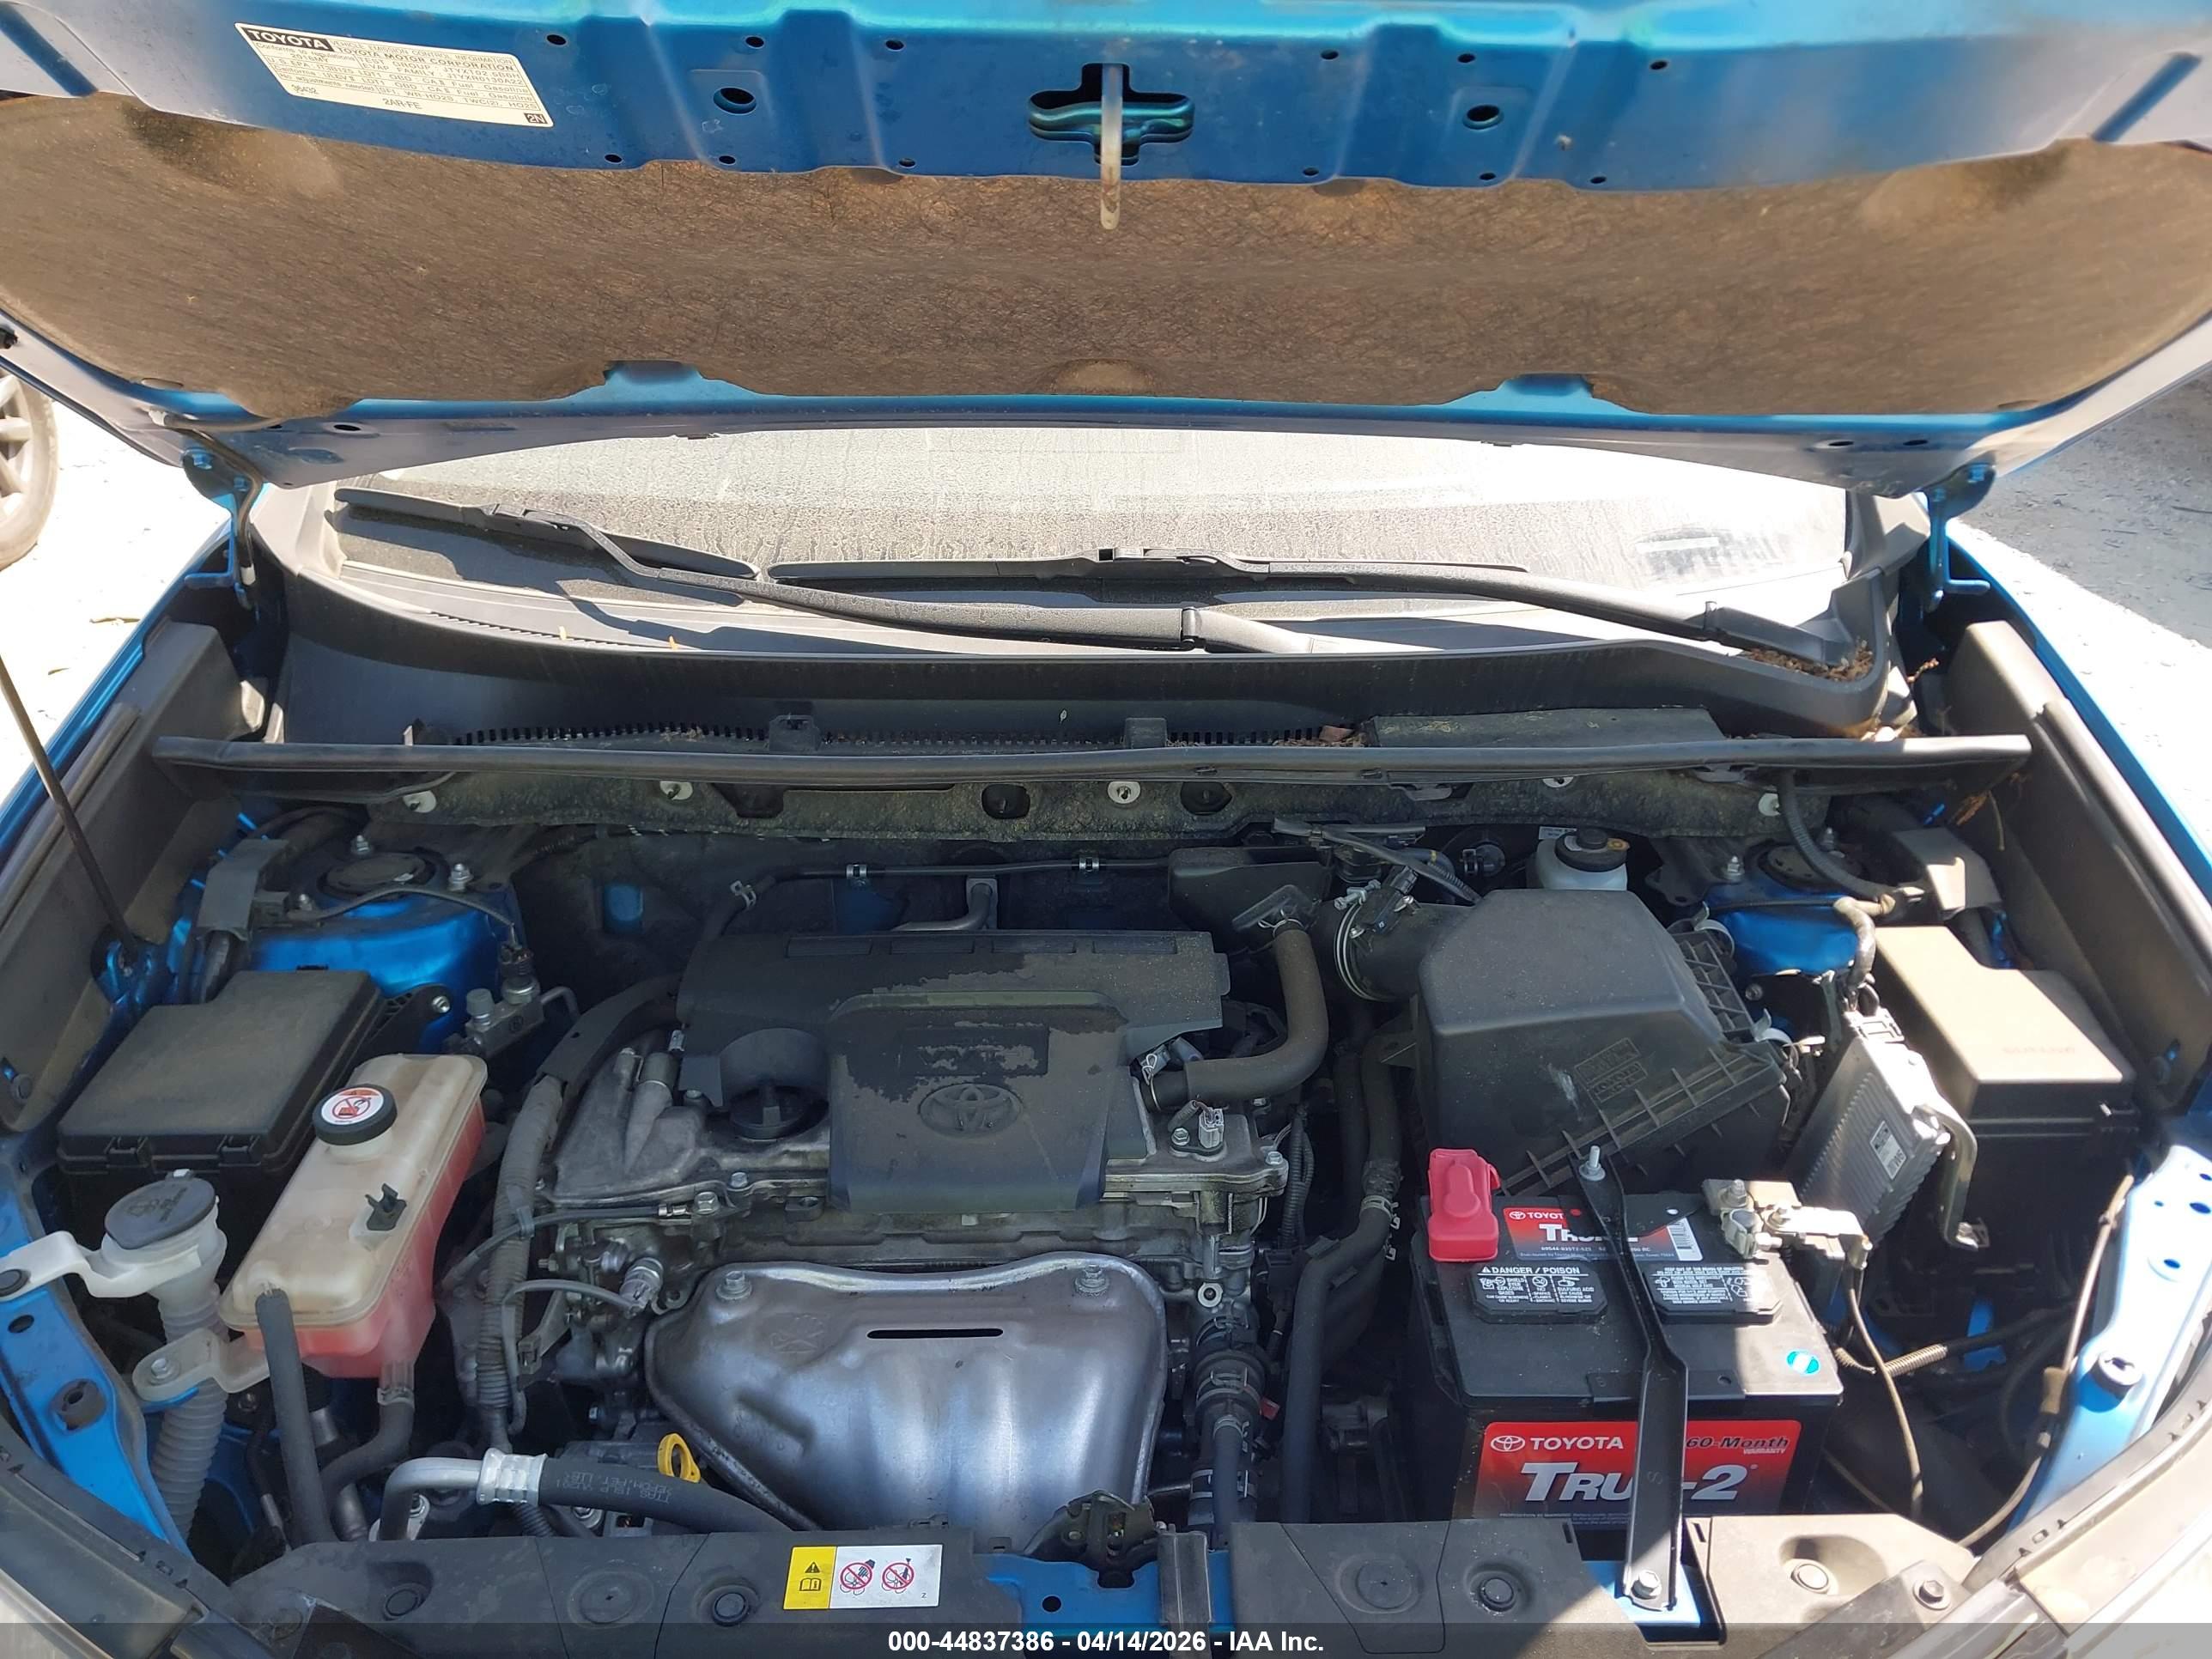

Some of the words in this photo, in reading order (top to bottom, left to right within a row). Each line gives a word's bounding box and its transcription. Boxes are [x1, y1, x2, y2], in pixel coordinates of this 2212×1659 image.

[246, 30, 329, 49] TOYOTA
[331, 40, 366, 50] VEHICLE
[367, 45, 410, 54] EMISSION
[410, 49, 450, 58] CONTROL
[453, 53, 514, 65] INFORMATION
[337, 47, 381, 58] TOYOTA
[383, 52, 426, 63] MOTOR
[428, 58, 515, 72] CORPORATION
[392, 61, 432, 70] GROUP
[362, 63, 391, 71] EVAP
[395, 67, 436, 76] FAMILY
[483, 83, 530, 94] Gasoline
[487, 92, 534, 103] Gasoline
[526, 113, 546, 124] 2N
[1530, 1437, 1624, 1449] TOYOTA
[1686, 1436, 1789, 1449] 60-Month
